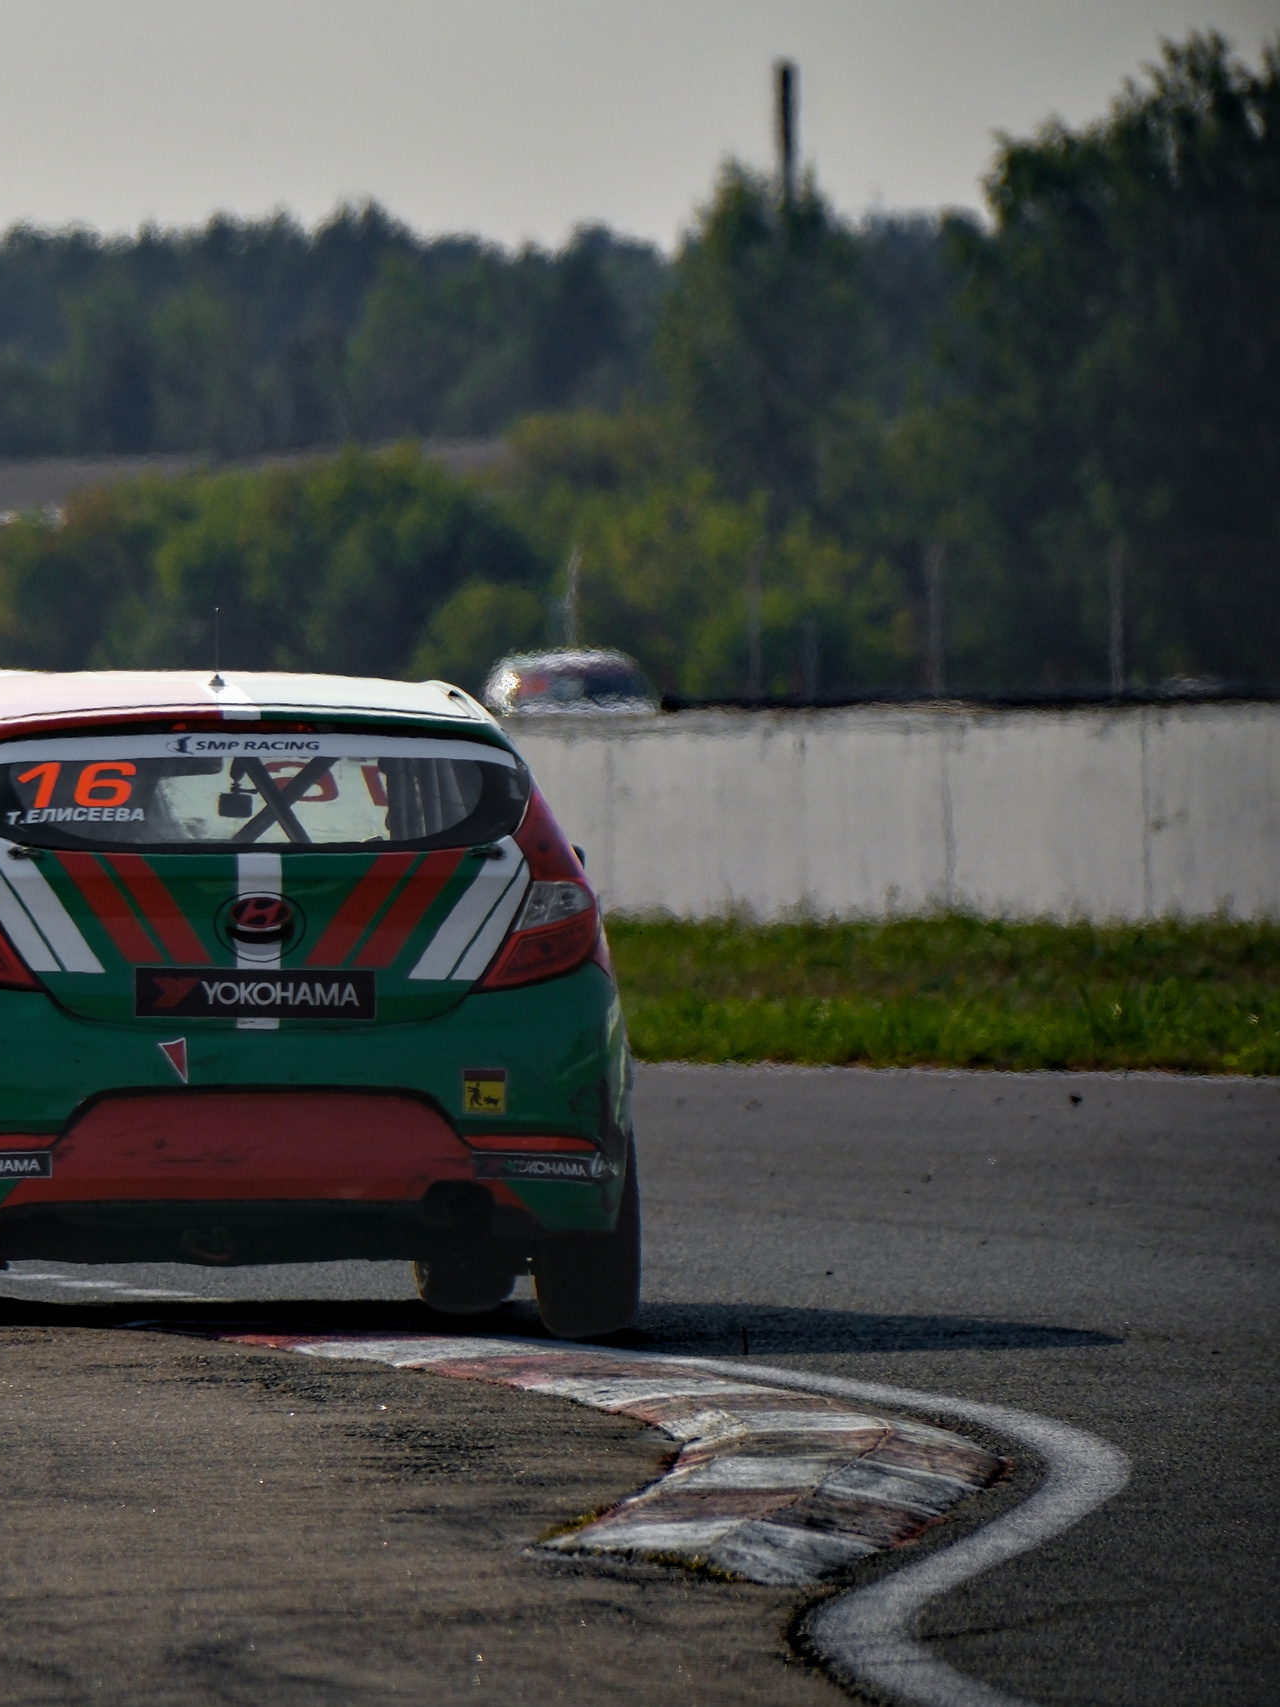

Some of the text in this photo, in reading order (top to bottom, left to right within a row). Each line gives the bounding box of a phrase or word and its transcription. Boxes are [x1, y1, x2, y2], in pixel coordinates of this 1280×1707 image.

[195, 740, 320, 751] SMP RACING
[17, 761, 138, 809] 16
[201, 981, 361, 1007] YOKOHAMA
